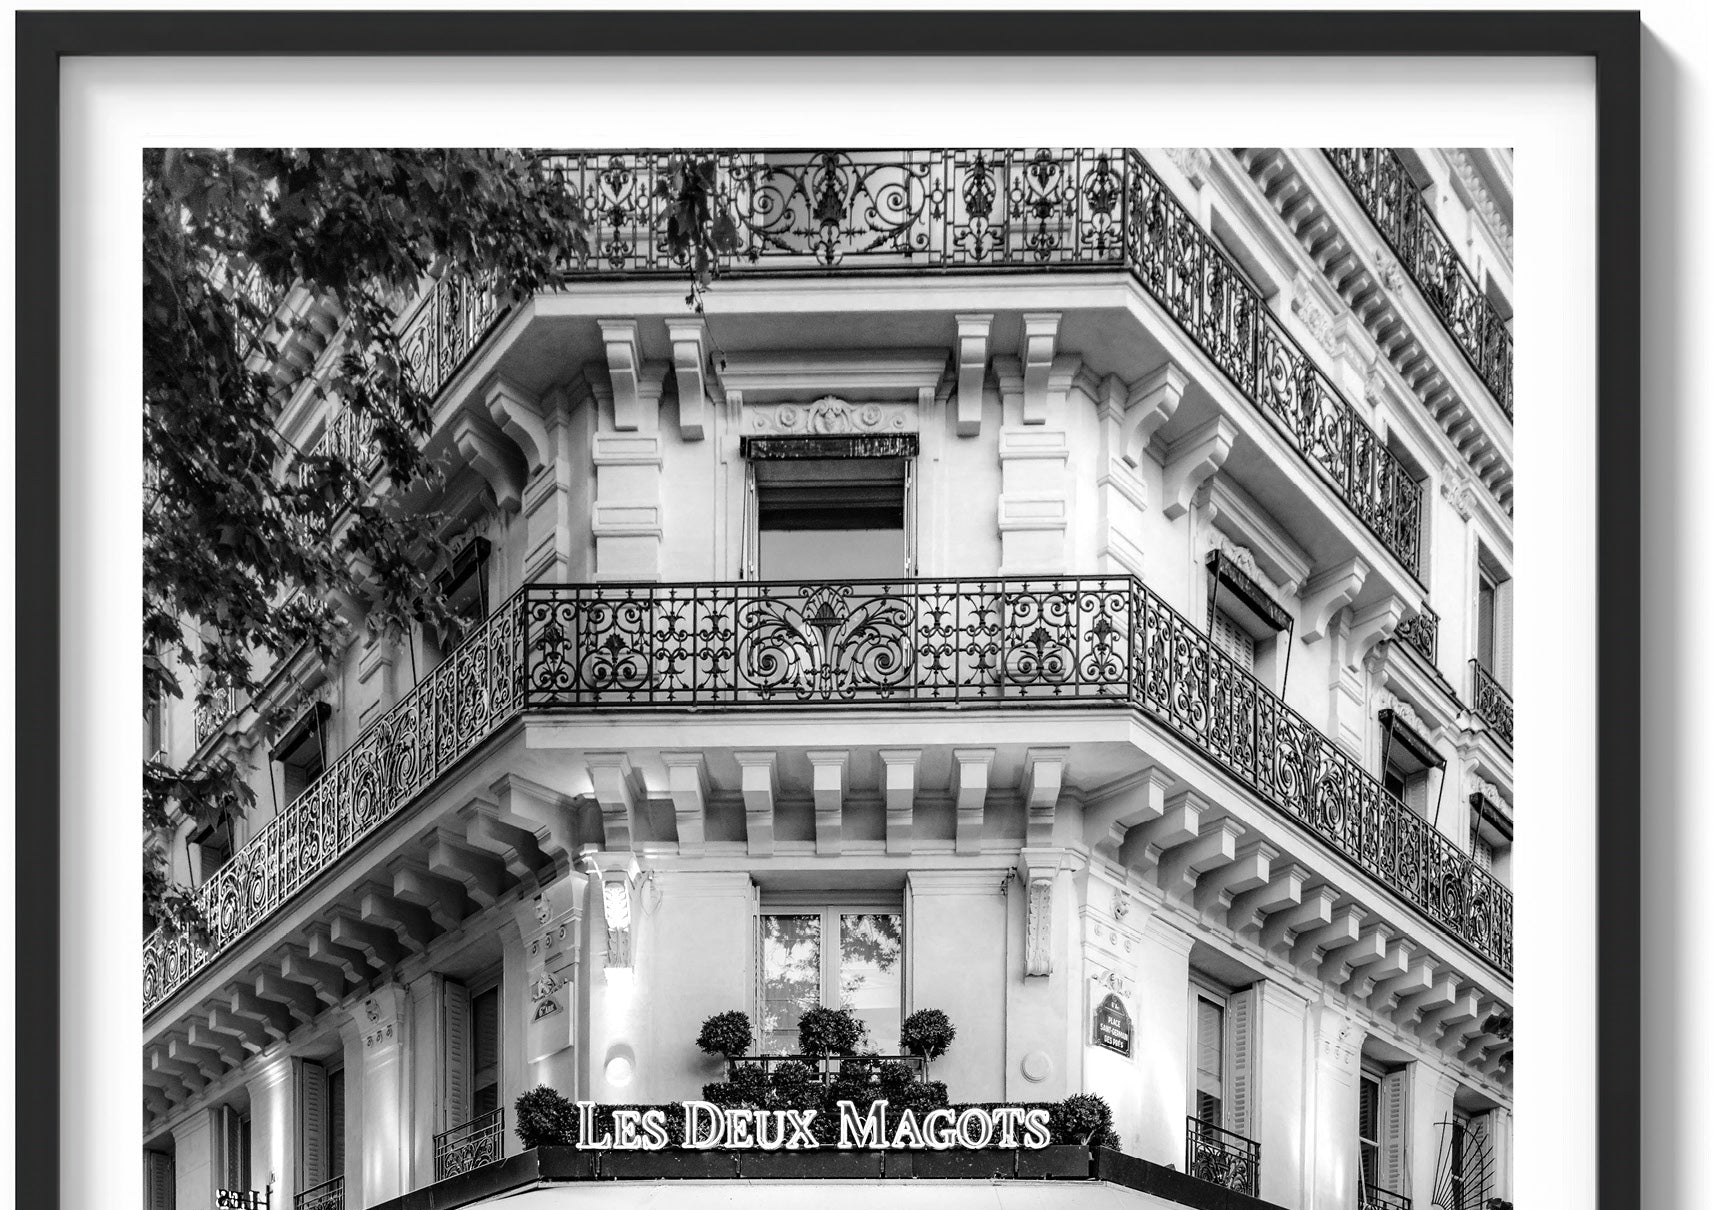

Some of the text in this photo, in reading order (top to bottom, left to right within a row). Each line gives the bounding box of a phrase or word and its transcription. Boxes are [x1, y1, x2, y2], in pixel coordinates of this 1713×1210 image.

[1107, 1016, 1121, 1028] PLACE
[576, 1100, 1051, 1150] LES DEUX MAGOTS
